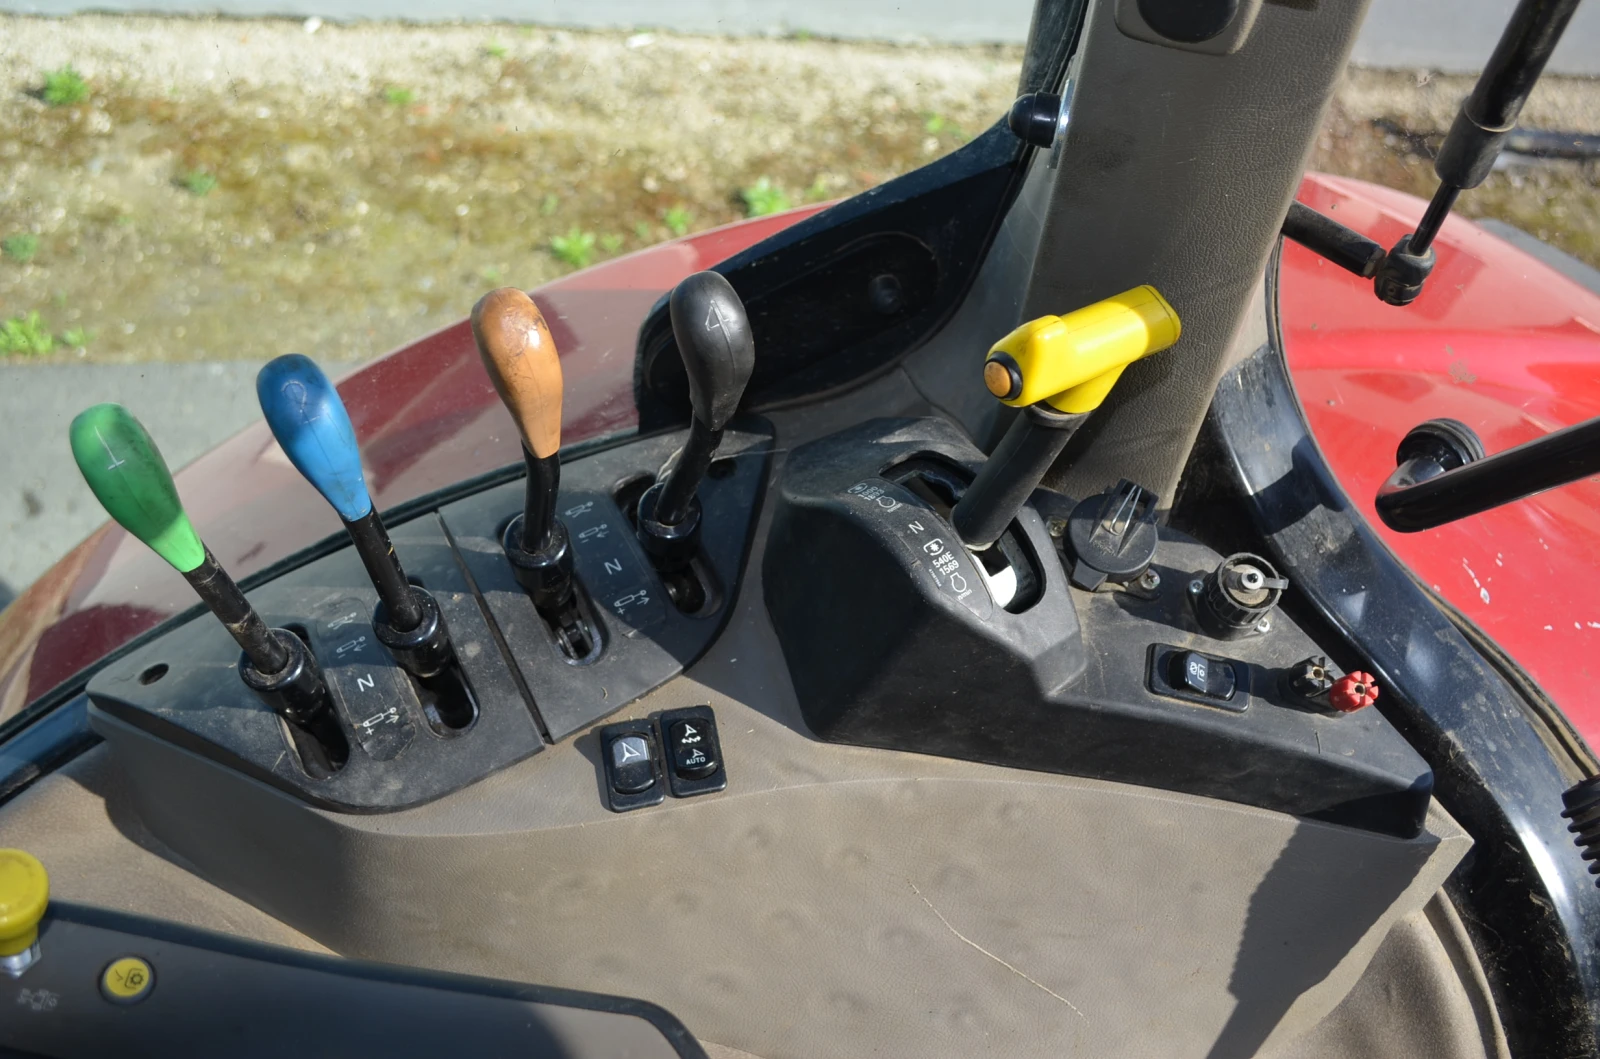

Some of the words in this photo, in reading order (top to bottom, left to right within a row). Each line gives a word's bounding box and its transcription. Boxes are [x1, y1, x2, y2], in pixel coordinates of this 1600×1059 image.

[908, 520, 925, 535] N
[604, 558, 623, 575] N
[932, 551, 955, 568] 540E
[938, 559, 960, 576] 1569
[357, 673, 375, 692] N
[685, 756, 706, 766] AUTO
